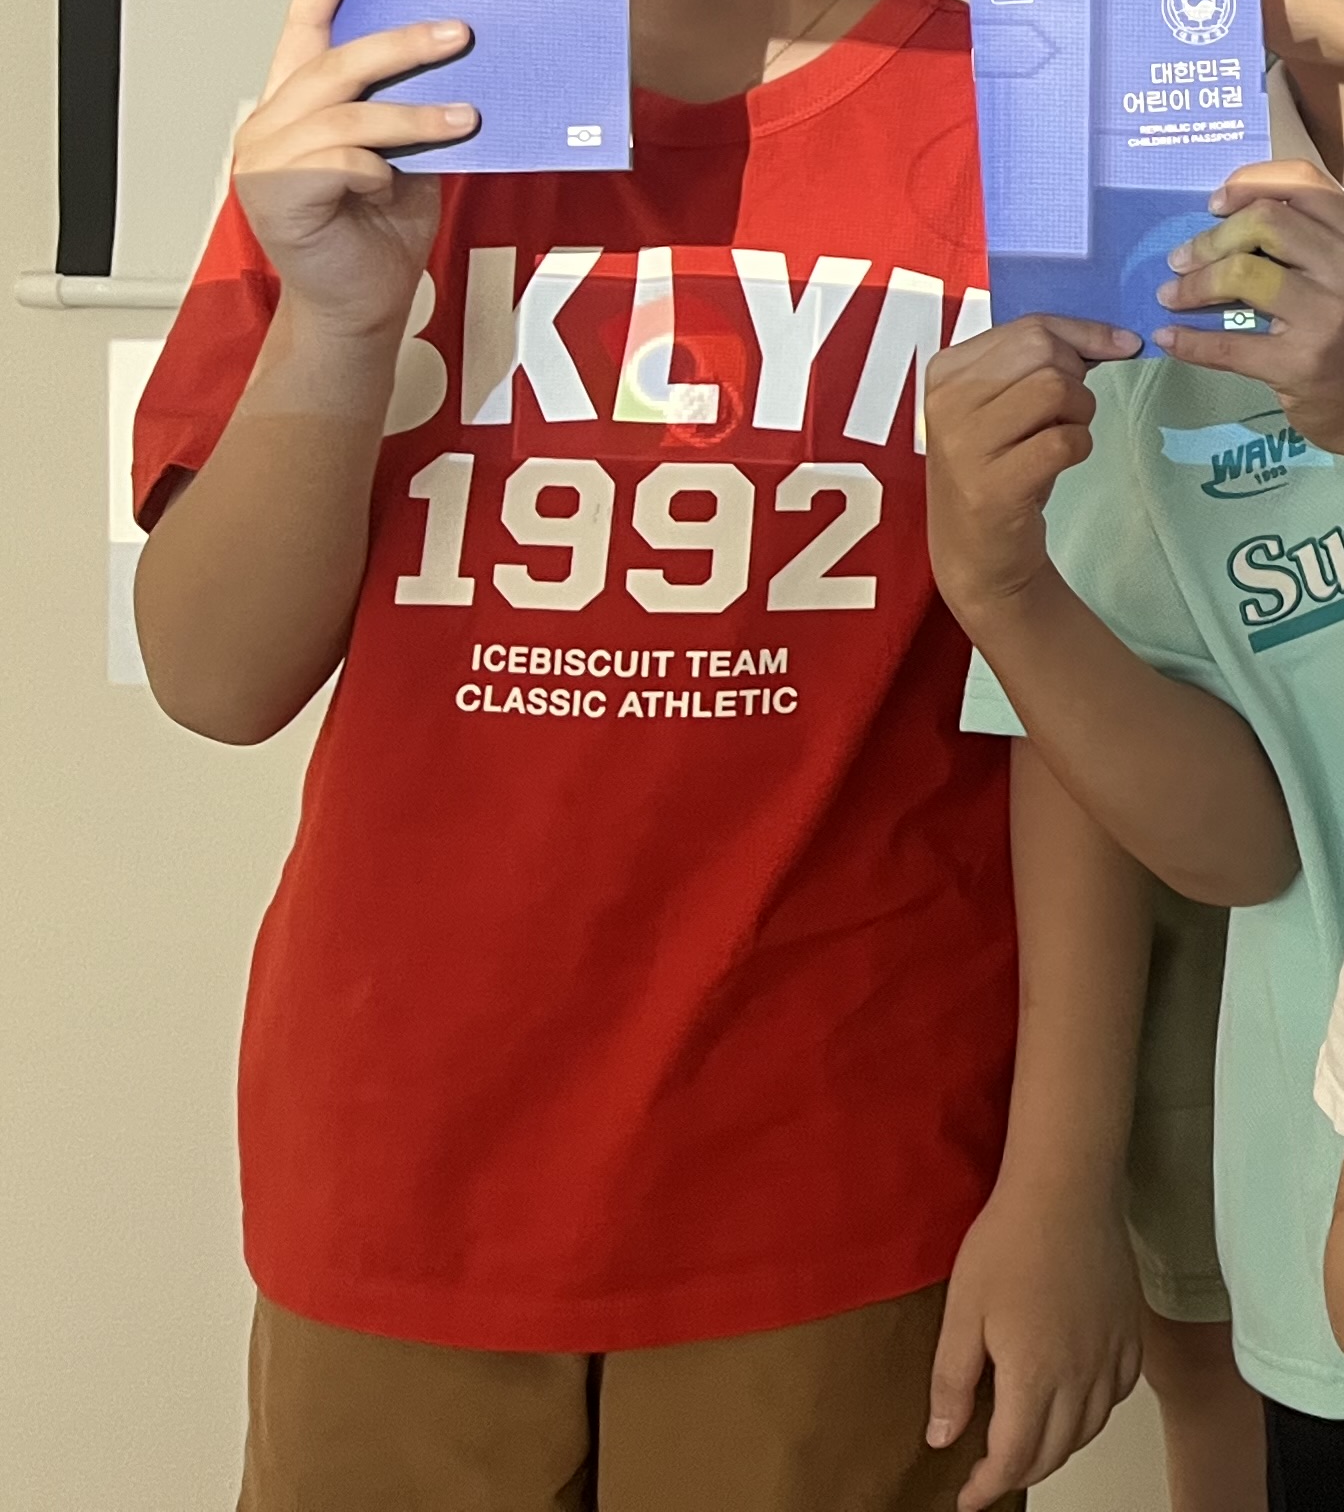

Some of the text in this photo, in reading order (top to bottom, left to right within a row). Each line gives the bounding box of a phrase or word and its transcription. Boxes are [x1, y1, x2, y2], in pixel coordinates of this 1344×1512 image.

[1150, 59, 1241, 85] 대한민국
[1123, 86, 1243, 114] 어린이 여권
[1211, 426, 1307, 484] WAVE
[394, 452, 884, 614] 1992
[471, 643, 789, 678] ICEBISCUIT TEAM
[455, 684, 799, 718] CLASSIC ATHLETIC
